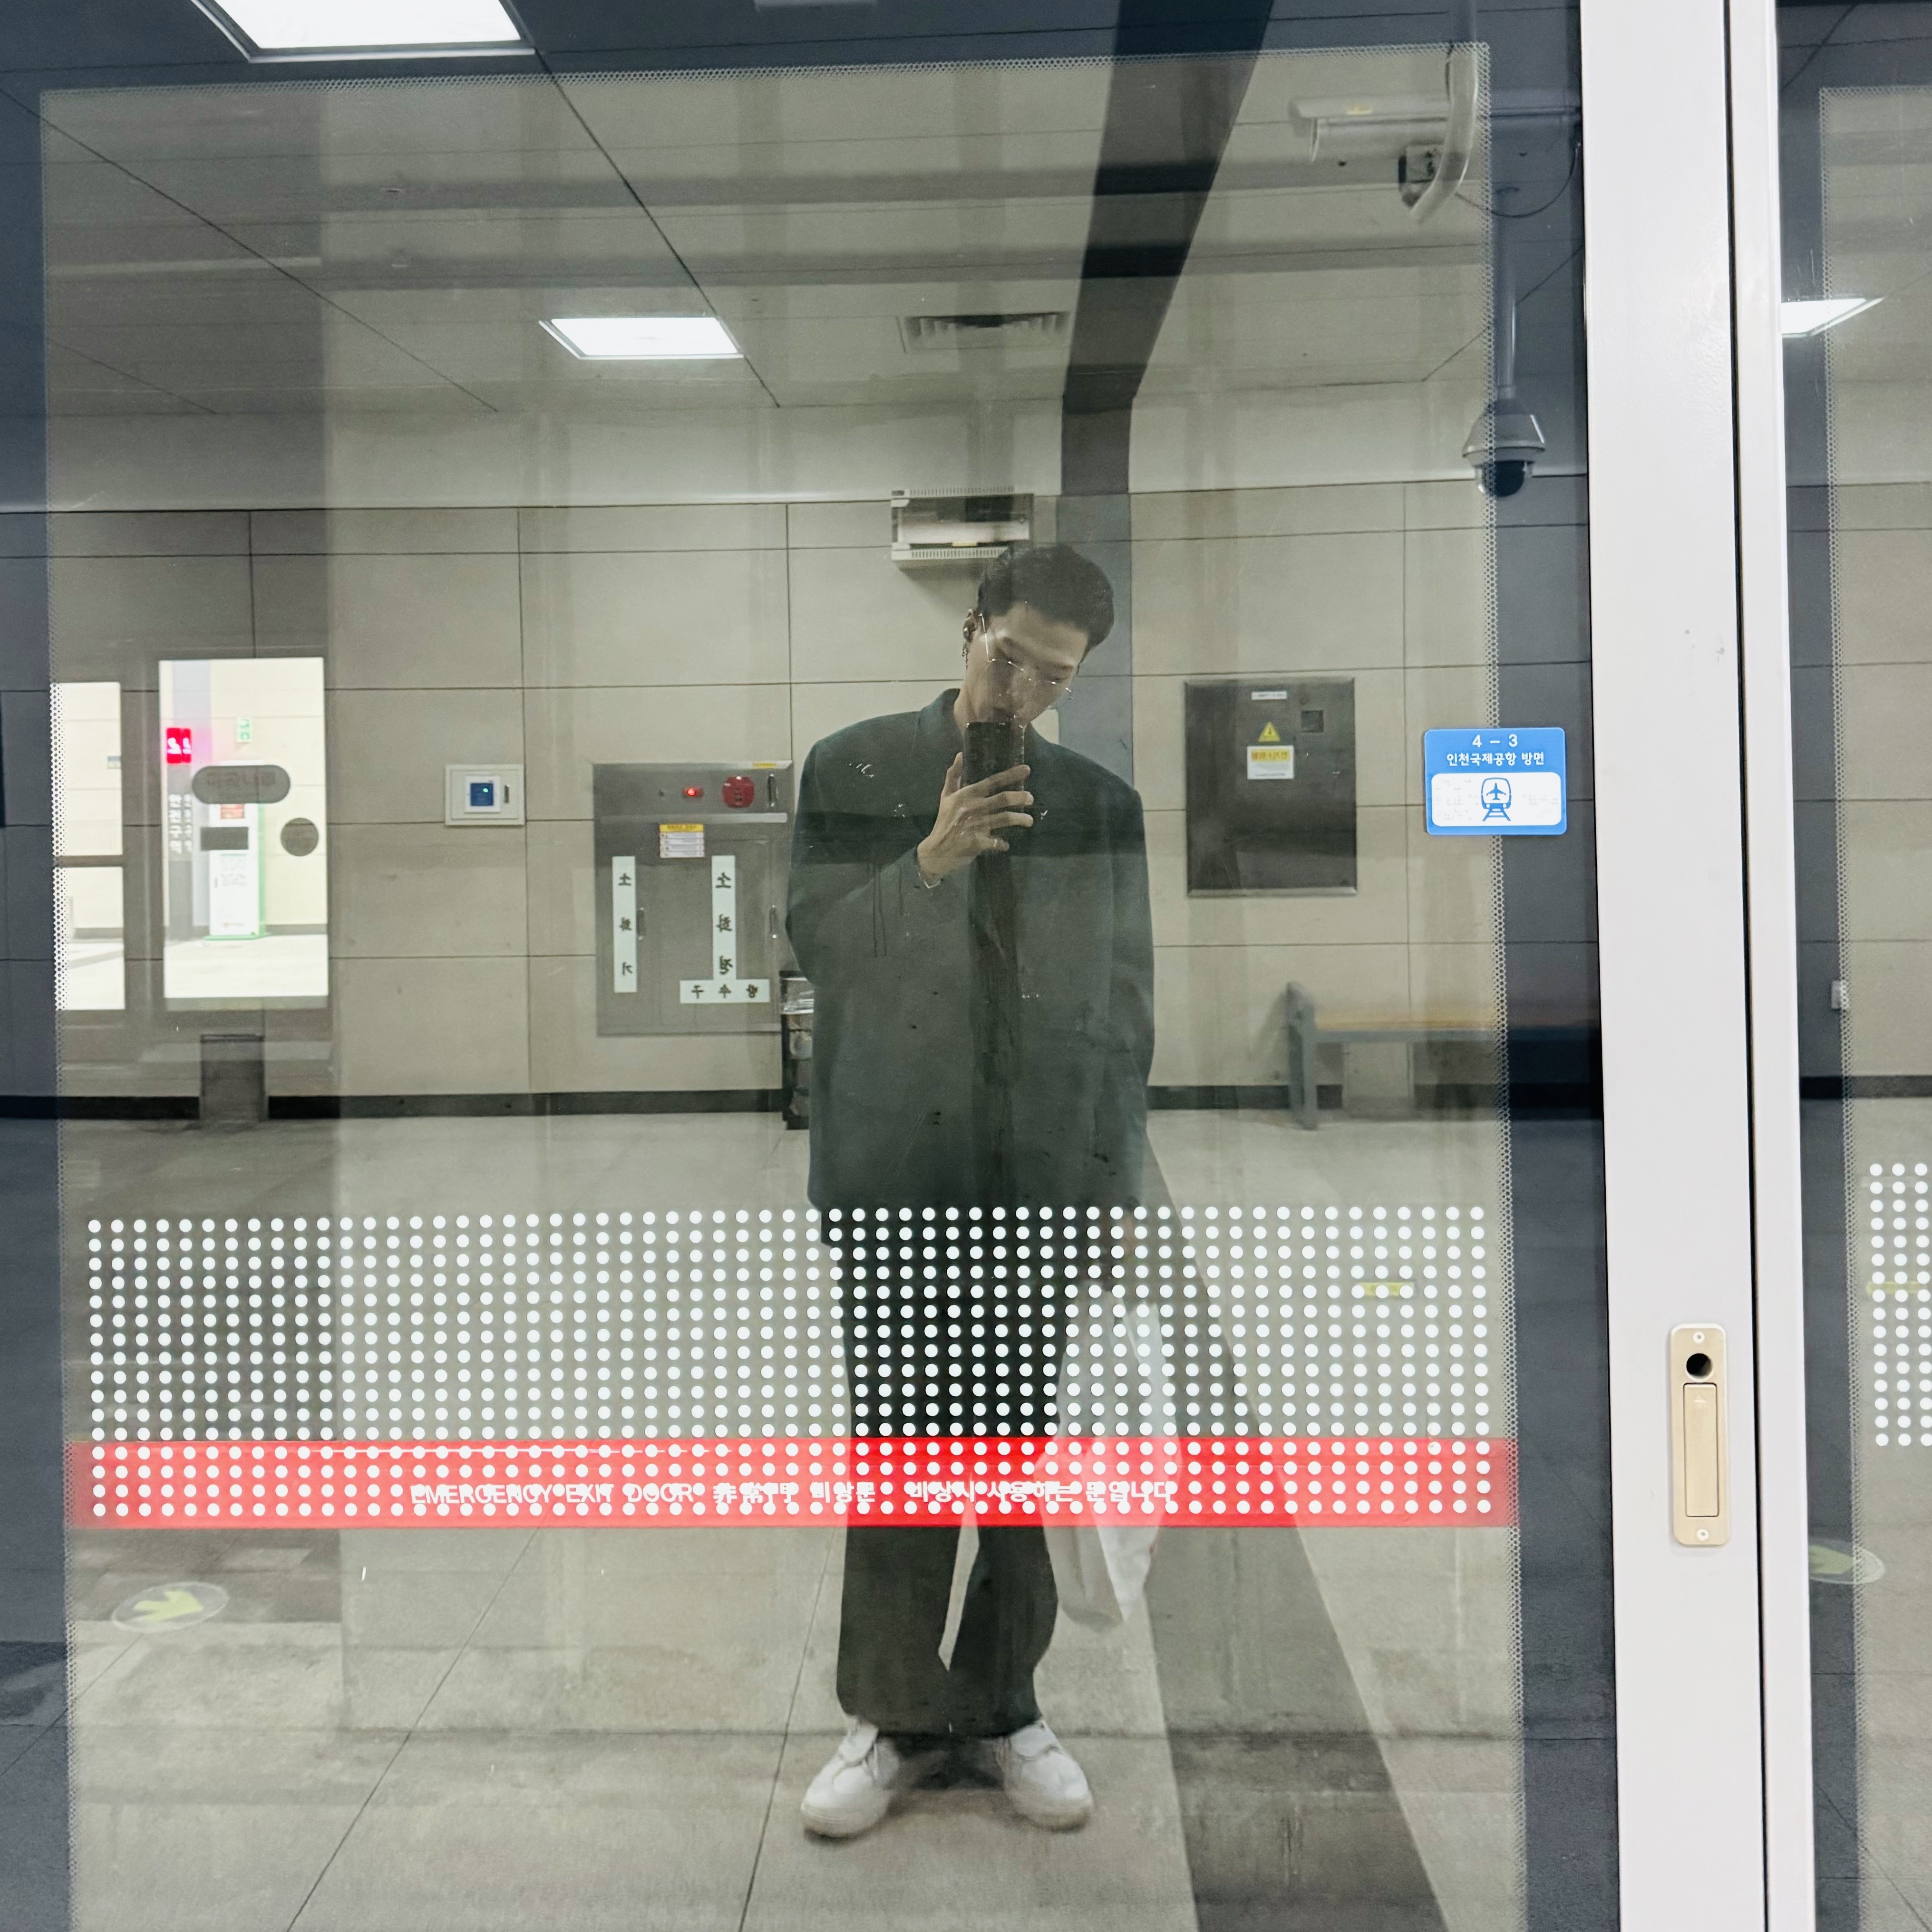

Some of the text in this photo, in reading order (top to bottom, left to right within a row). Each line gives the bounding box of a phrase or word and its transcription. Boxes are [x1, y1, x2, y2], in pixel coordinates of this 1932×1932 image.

[1472, 734, 1482, 748] 4
[1508, 734, 1518, 747] 3
[1446, 752, 1545, 766] 인천국제공항 방면
[410, 1482, 694, 1504] EMERGENCY EXIT DOOR
